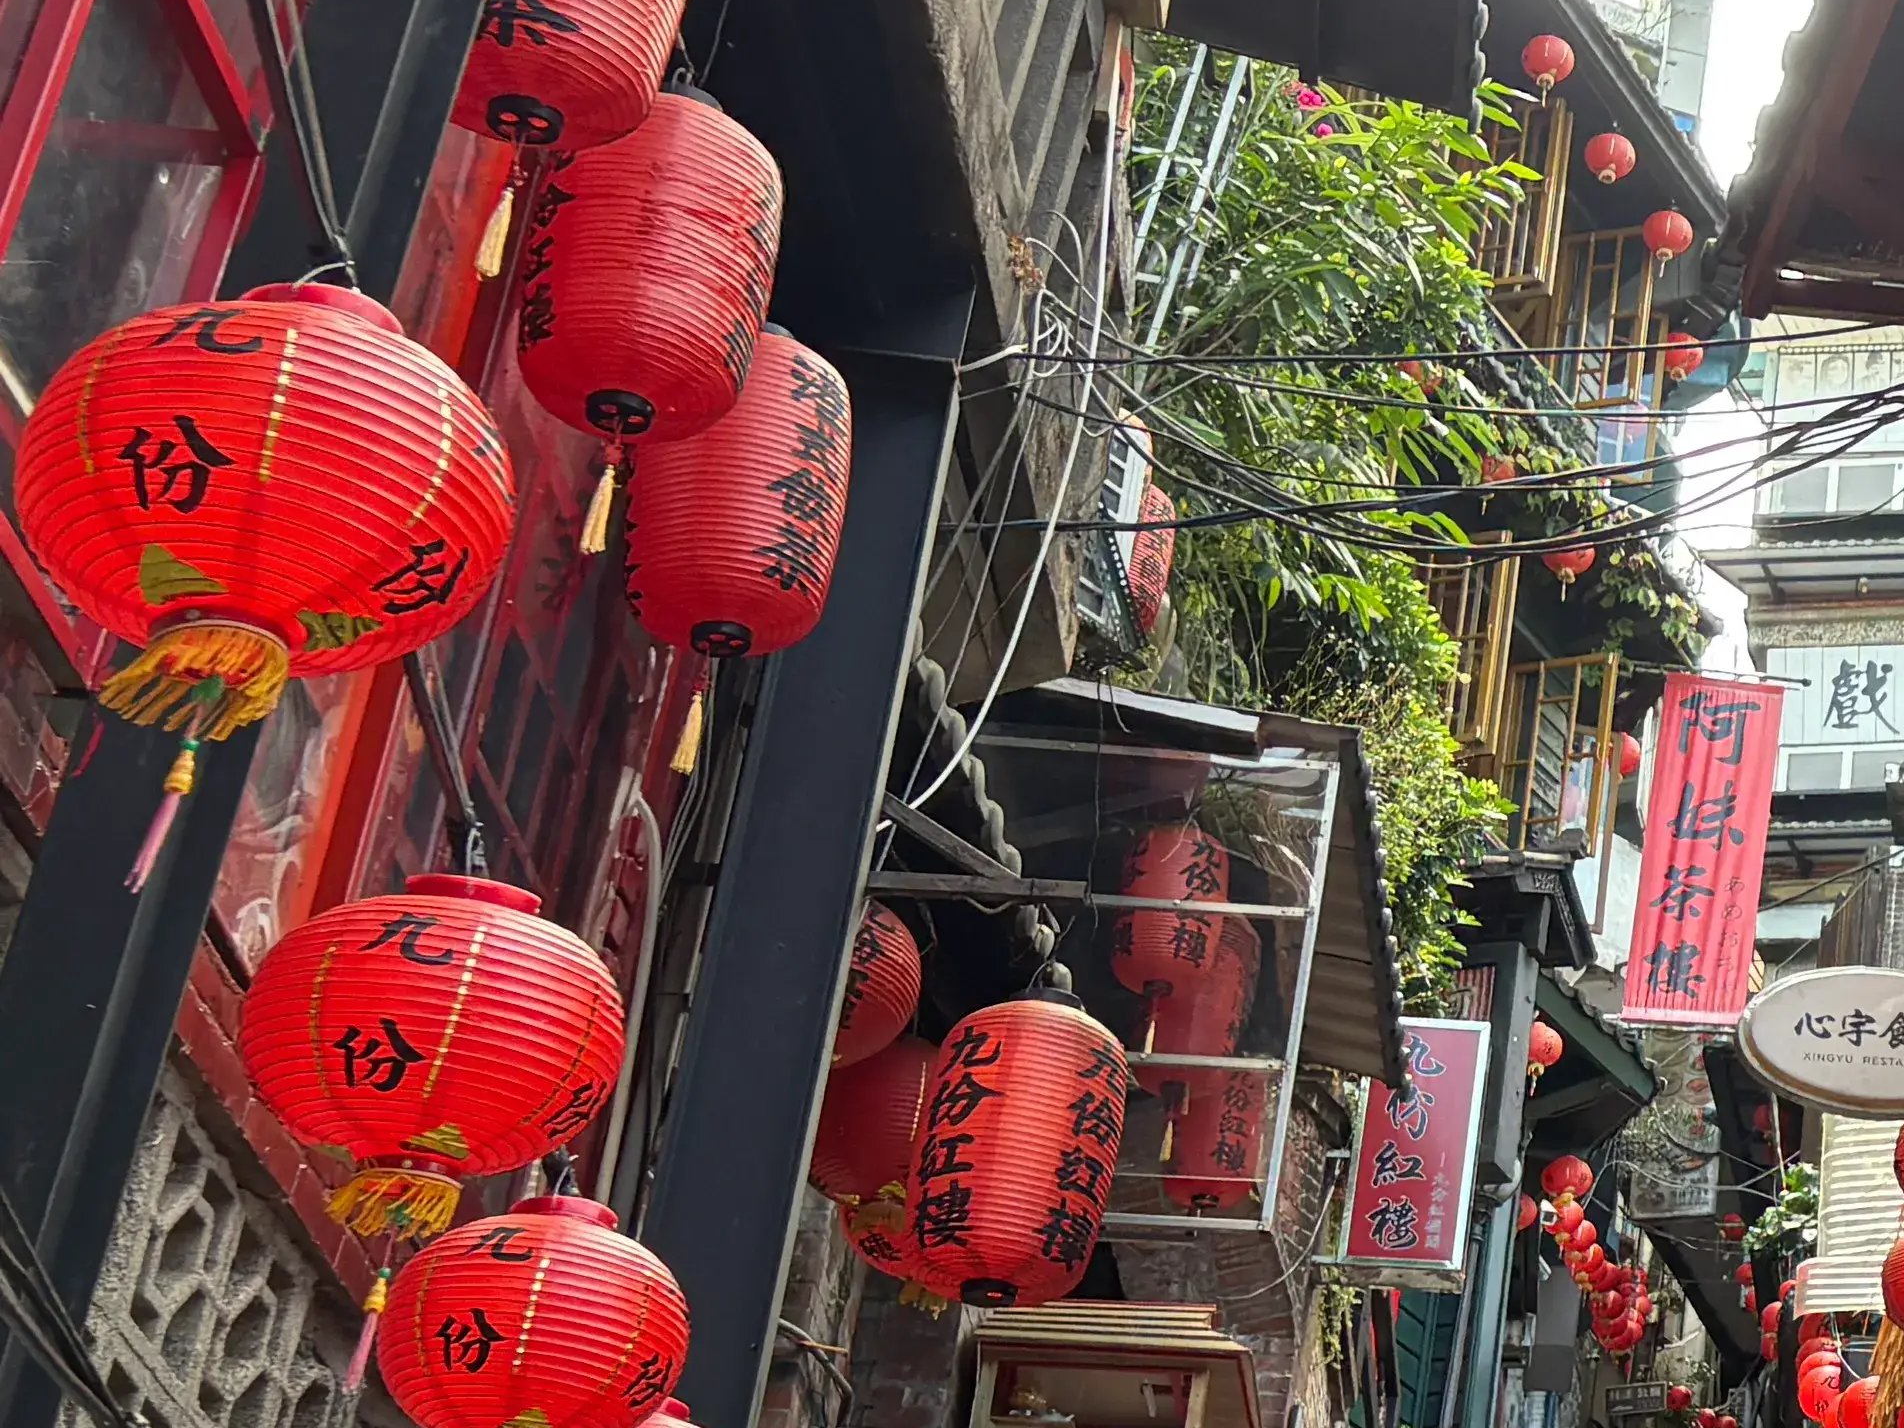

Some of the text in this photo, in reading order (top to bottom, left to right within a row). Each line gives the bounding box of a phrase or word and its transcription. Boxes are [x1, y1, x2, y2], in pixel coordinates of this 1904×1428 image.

[117, 307, 265, 514] 九份
[1644, 690, 1761, 999] 阿妹茶樓
[333, 911, 458, 1094] 九份
[1803, 1051, 1854, 1065] XINGYU
[914, 1025, 1003, 1250] 九份紅樓
[1366, 1033, 1448, 1251] 九份紅樓
[436, 1225, 534, 1375] 九份
